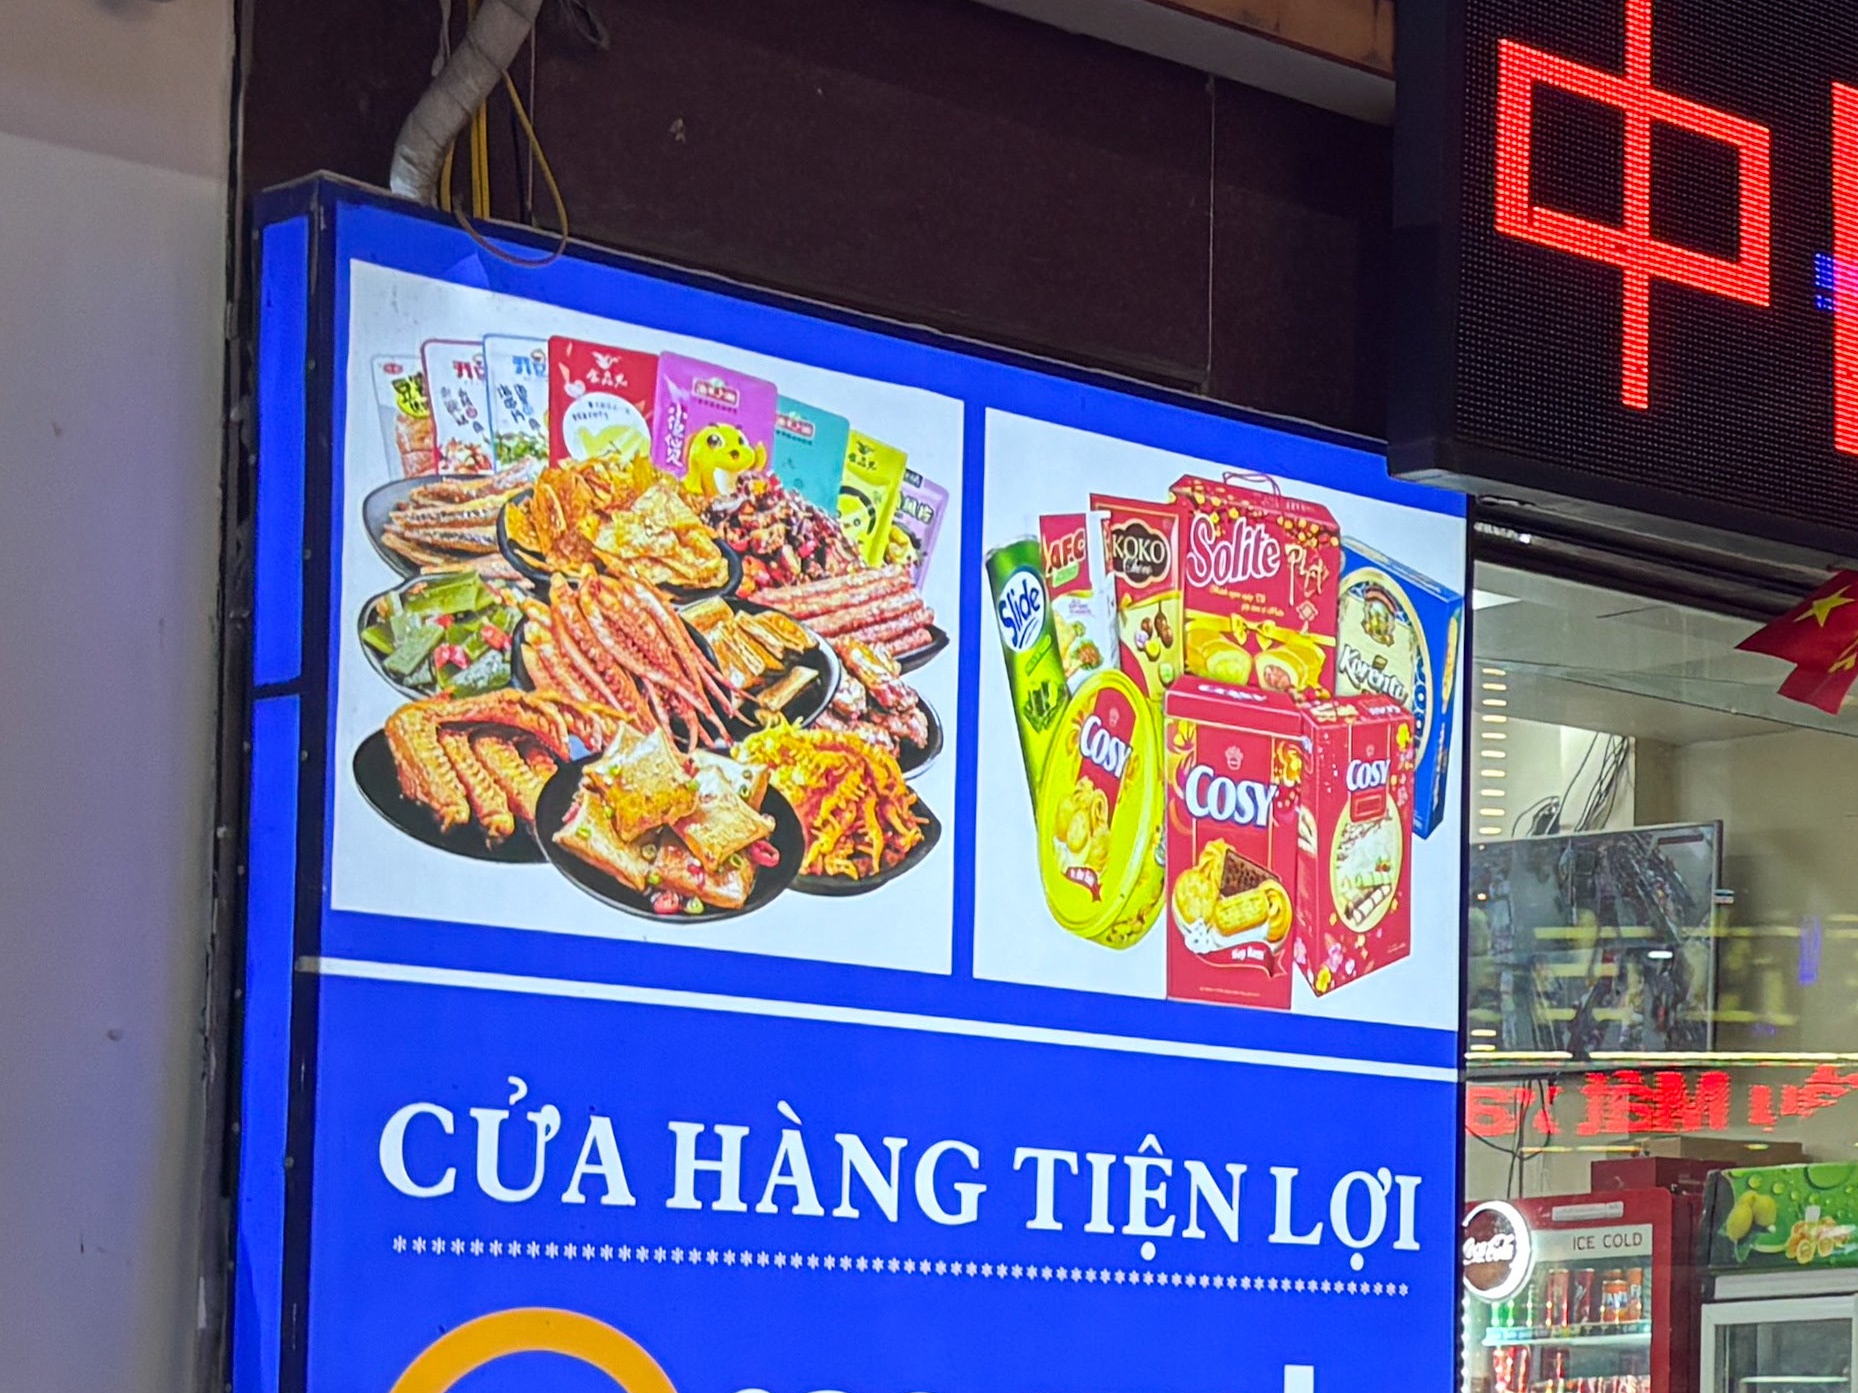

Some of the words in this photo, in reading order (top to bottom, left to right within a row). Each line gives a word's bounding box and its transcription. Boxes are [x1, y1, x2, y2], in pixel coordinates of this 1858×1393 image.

[1186, 512, 1282, 587] Solite
[378, 1075, 636, 1209] CỬA
[666, 1100, 988, 1229] HÀNG
[1011, 1135, 1247, 1261] TIỆN
[1271, 1165, 1421, 1271] LỢI
[1572, 1235, 1595, 1251] ICE
[1603, 1231, 1643, 1249] COLD
